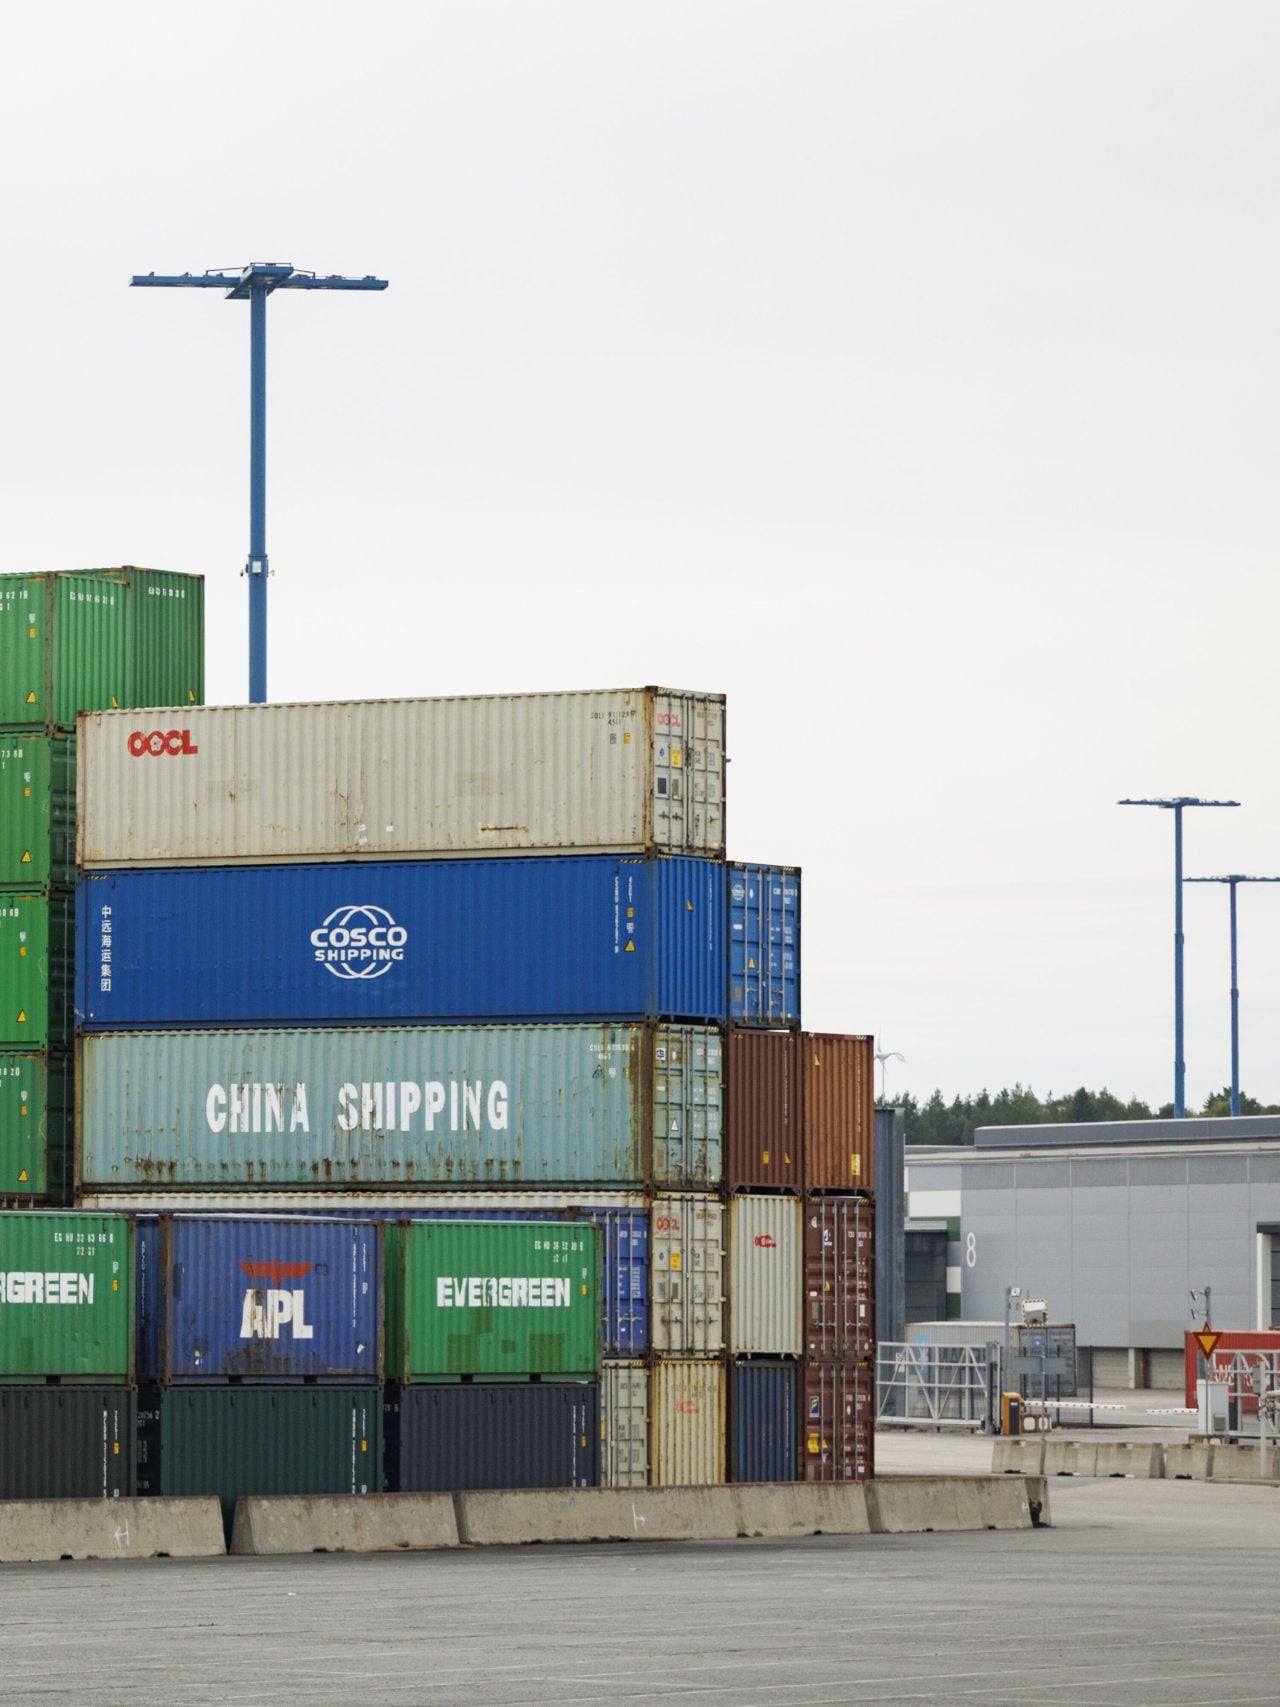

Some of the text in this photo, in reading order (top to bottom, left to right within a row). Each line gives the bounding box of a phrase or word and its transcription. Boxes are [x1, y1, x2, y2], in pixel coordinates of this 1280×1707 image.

[128, 729, 199, 758] OOCL
[310, 926, 408, 948] COSCO
[314, 948, 404, 961] SHIPPING
[205, 1082, 310, 1133] CHINA
[336, 1079, 509, 1132] SHIPPING
[966, 1231, 977, 1268] 8
[436, 1277, 571, 1307] EVERGREEN
[239, 1288, 314, 1339] APL
